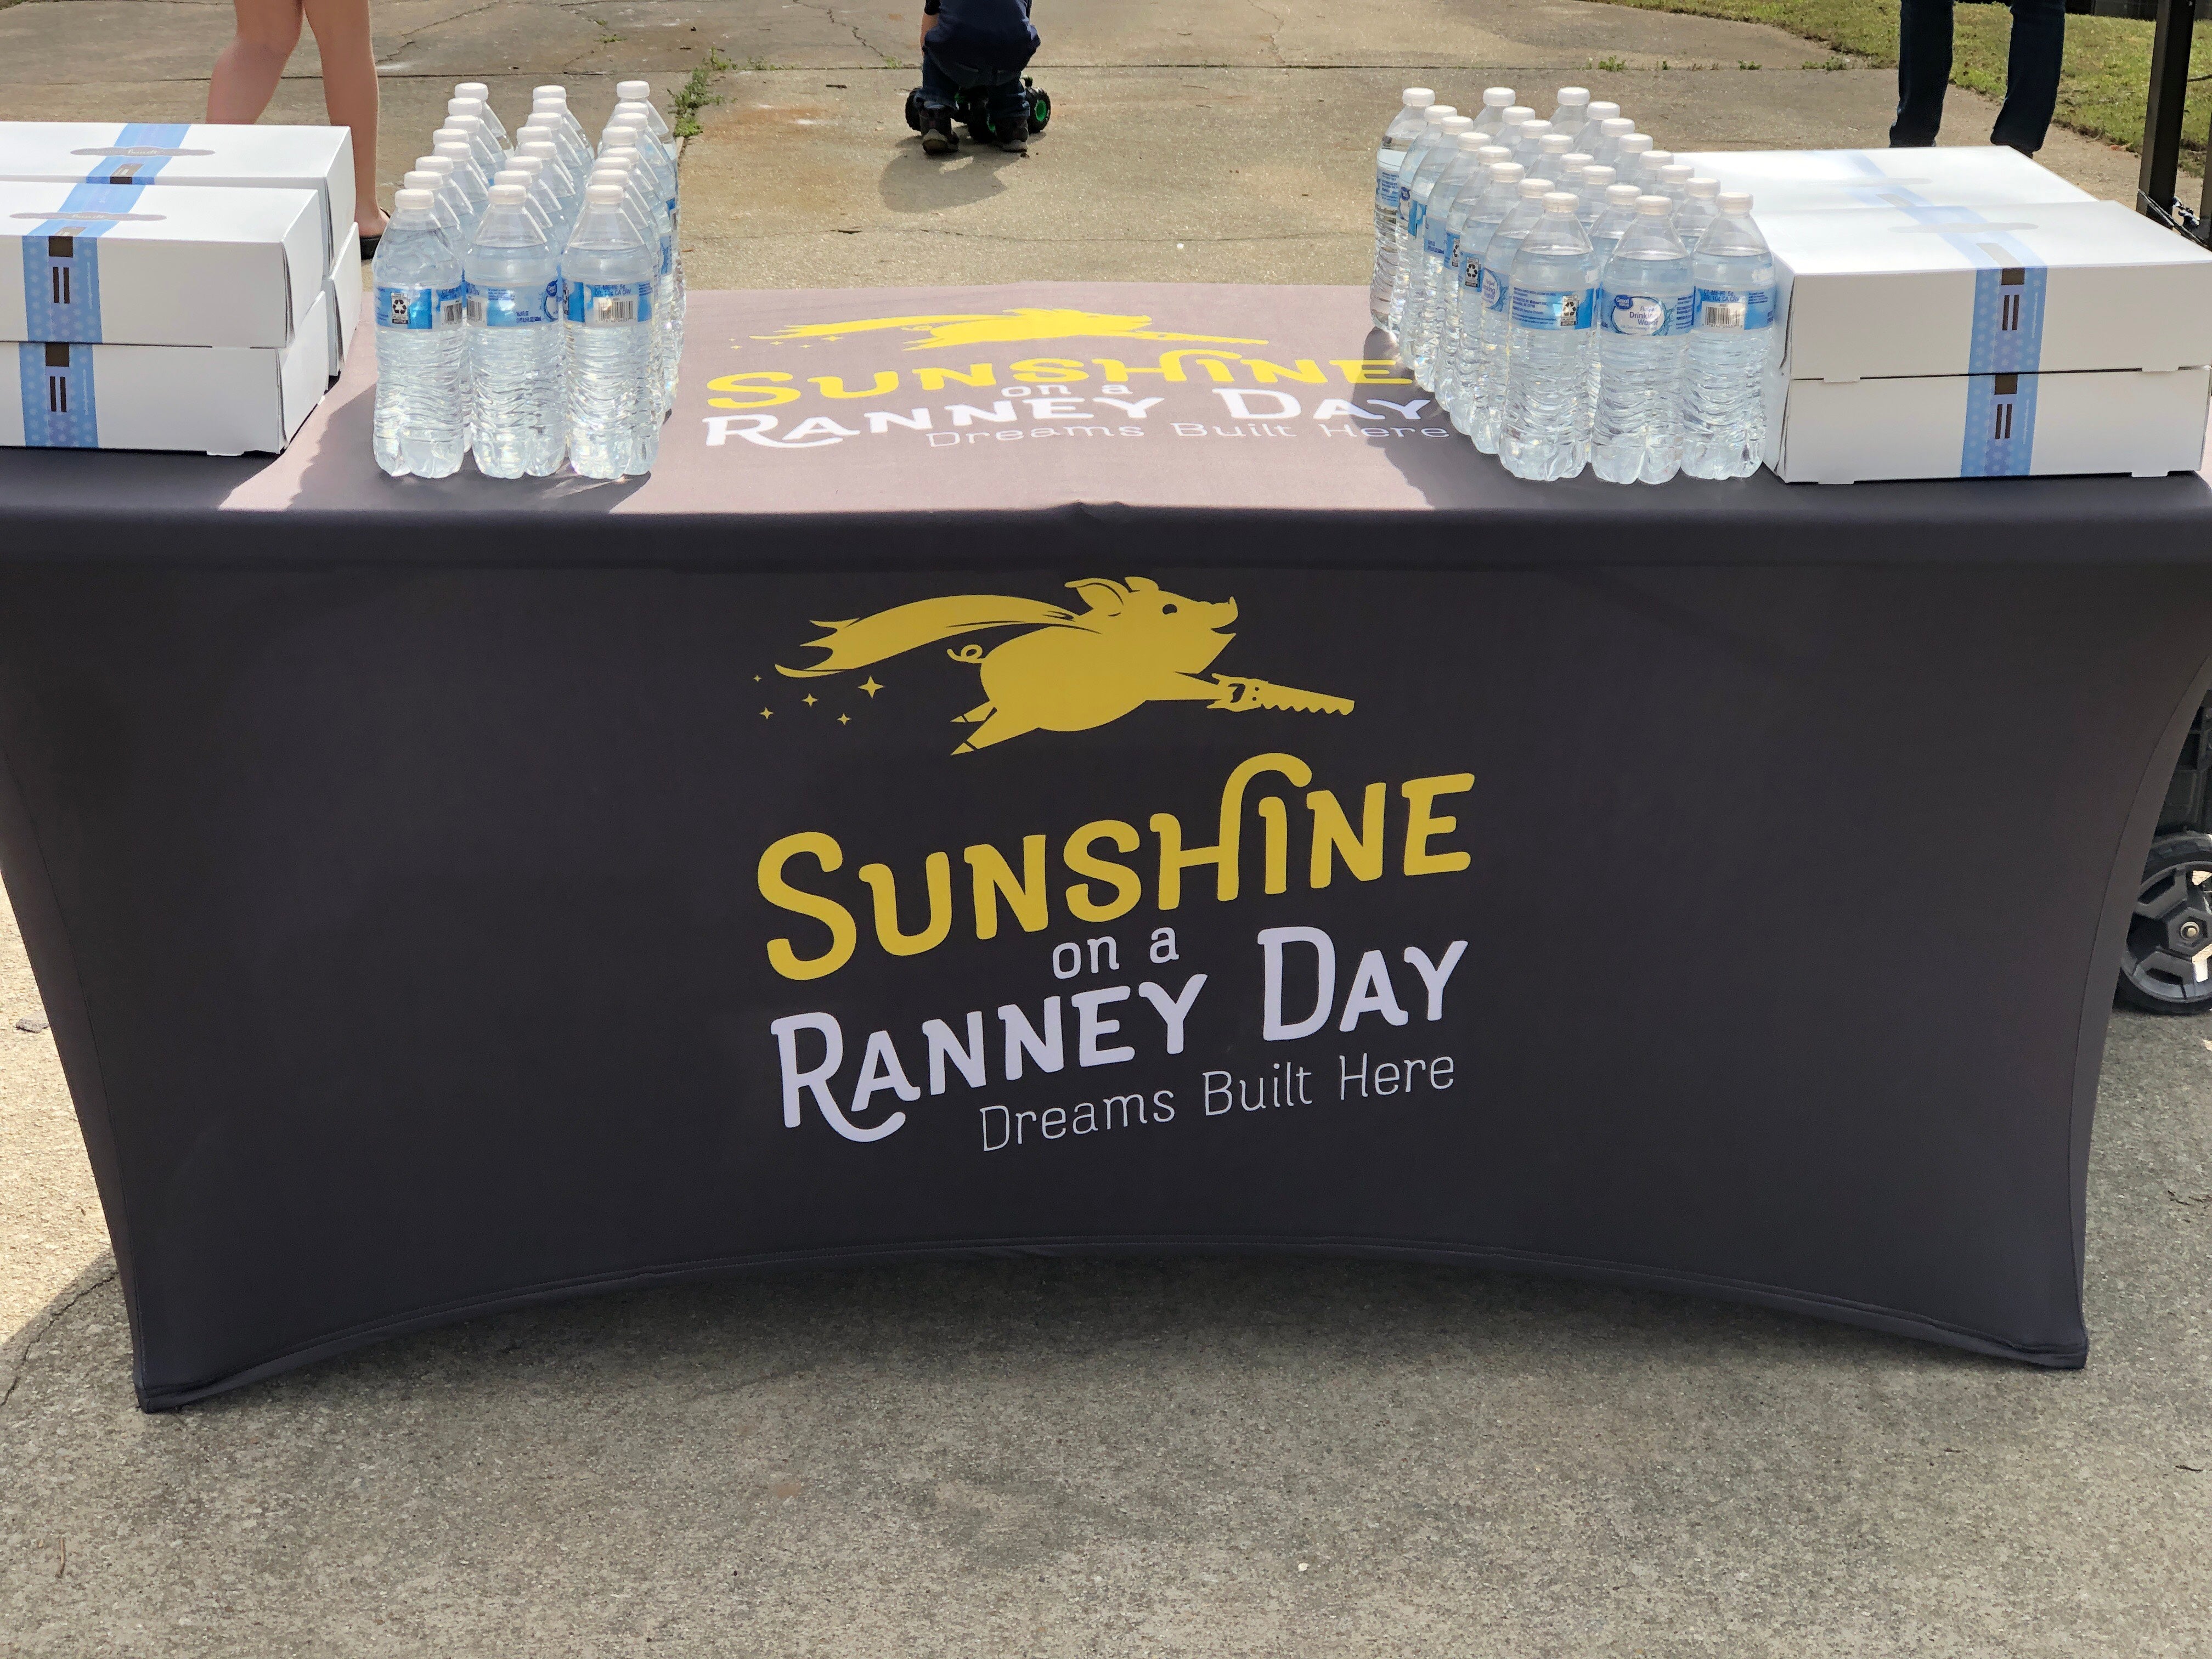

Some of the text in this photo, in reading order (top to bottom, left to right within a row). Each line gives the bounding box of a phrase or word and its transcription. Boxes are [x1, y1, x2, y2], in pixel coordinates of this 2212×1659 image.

[706, 348, 1413, 409] SUNSHINE
[1000, 383, 1133, 398] on a
[701, 387, 1431, 448] RANNEY DAY
[926, 422, 1451, 448] Dreams Built Here
[758, 752, 1475, 980] SUNSHINE
[1052, 927, 1180, 979] on a
[770, 926, 1469, 1143] RANNEY DAY
[979, 1052, 1454, 1152] Dreams Built Here
